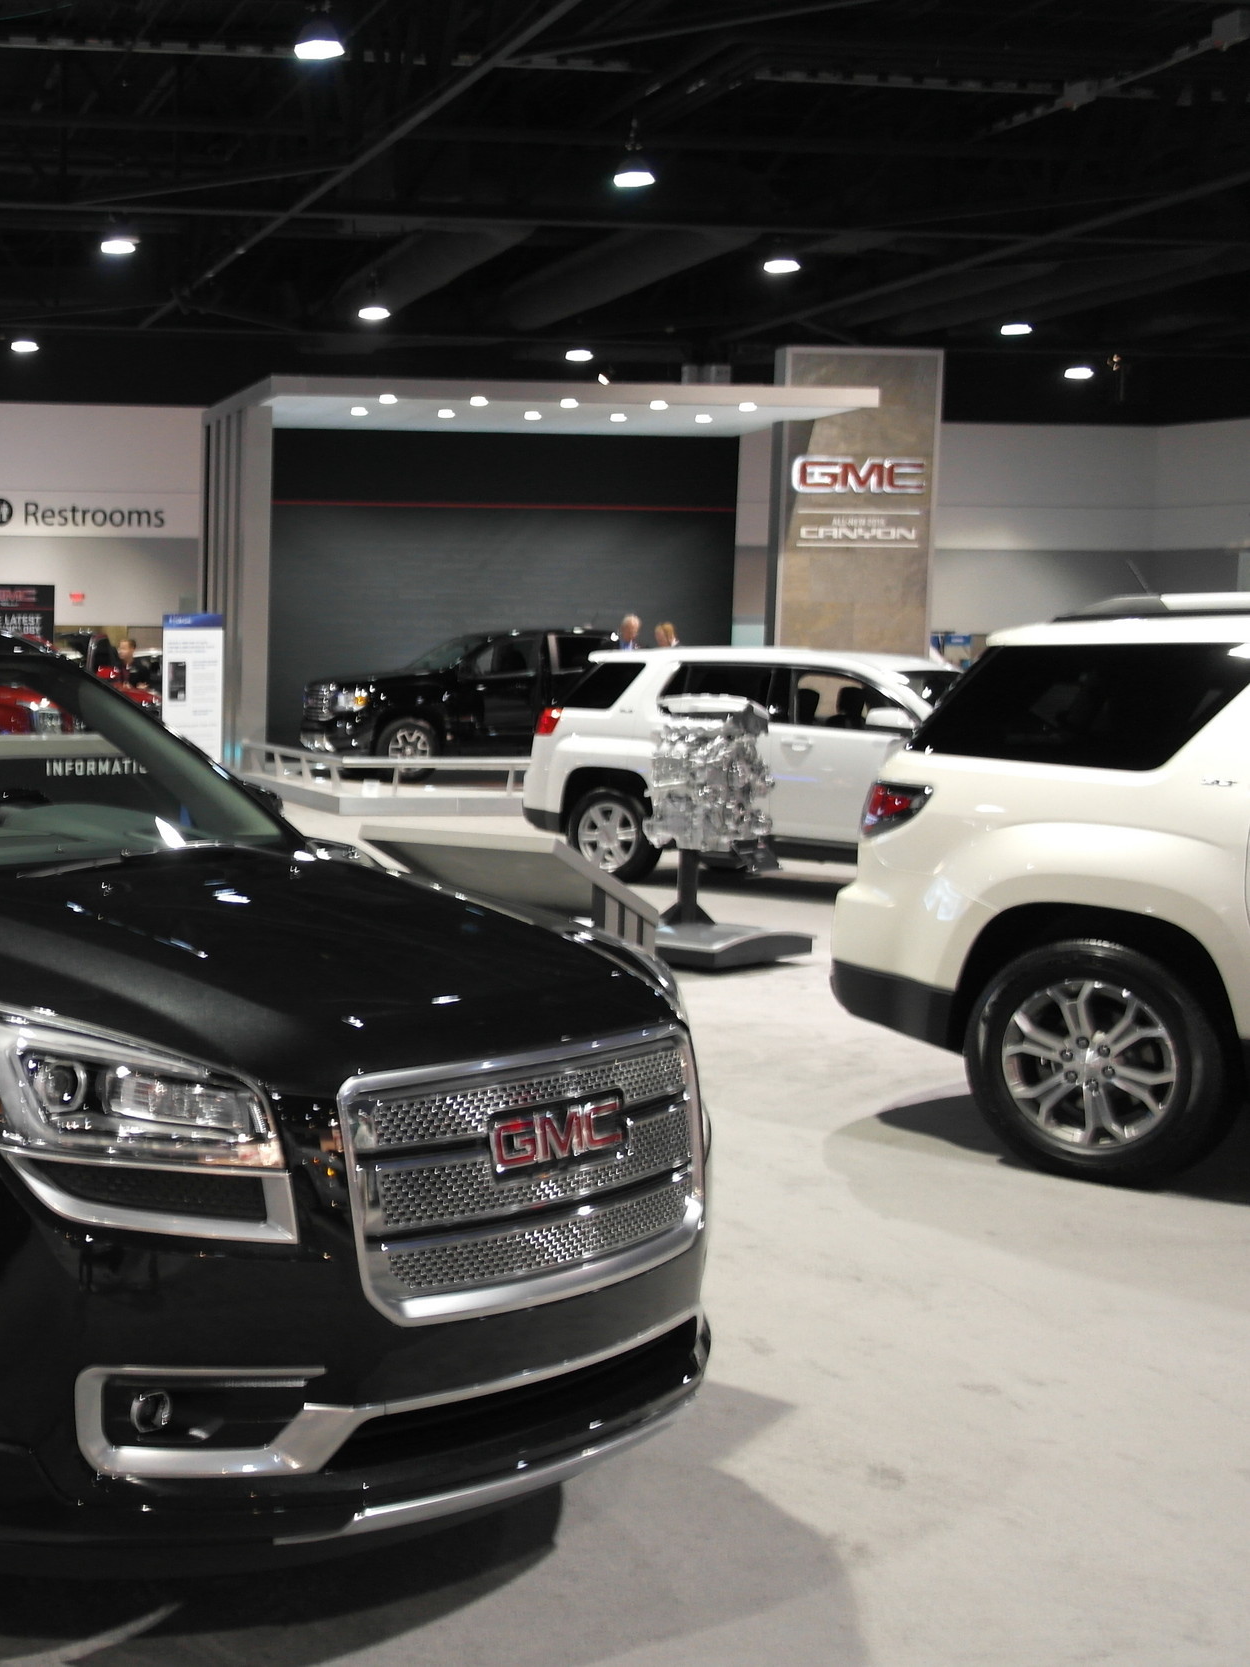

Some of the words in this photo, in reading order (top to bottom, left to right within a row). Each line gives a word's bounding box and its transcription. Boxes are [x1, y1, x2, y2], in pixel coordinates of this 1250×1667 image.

[792, 456, 925, 493] GMC
[23, 501, 165, 529] Restrooms
[799, 526, 916, 541] CANYON
[4, 613, 42, 627] LATEST
[490, 1098, 626, 1169] GMC
